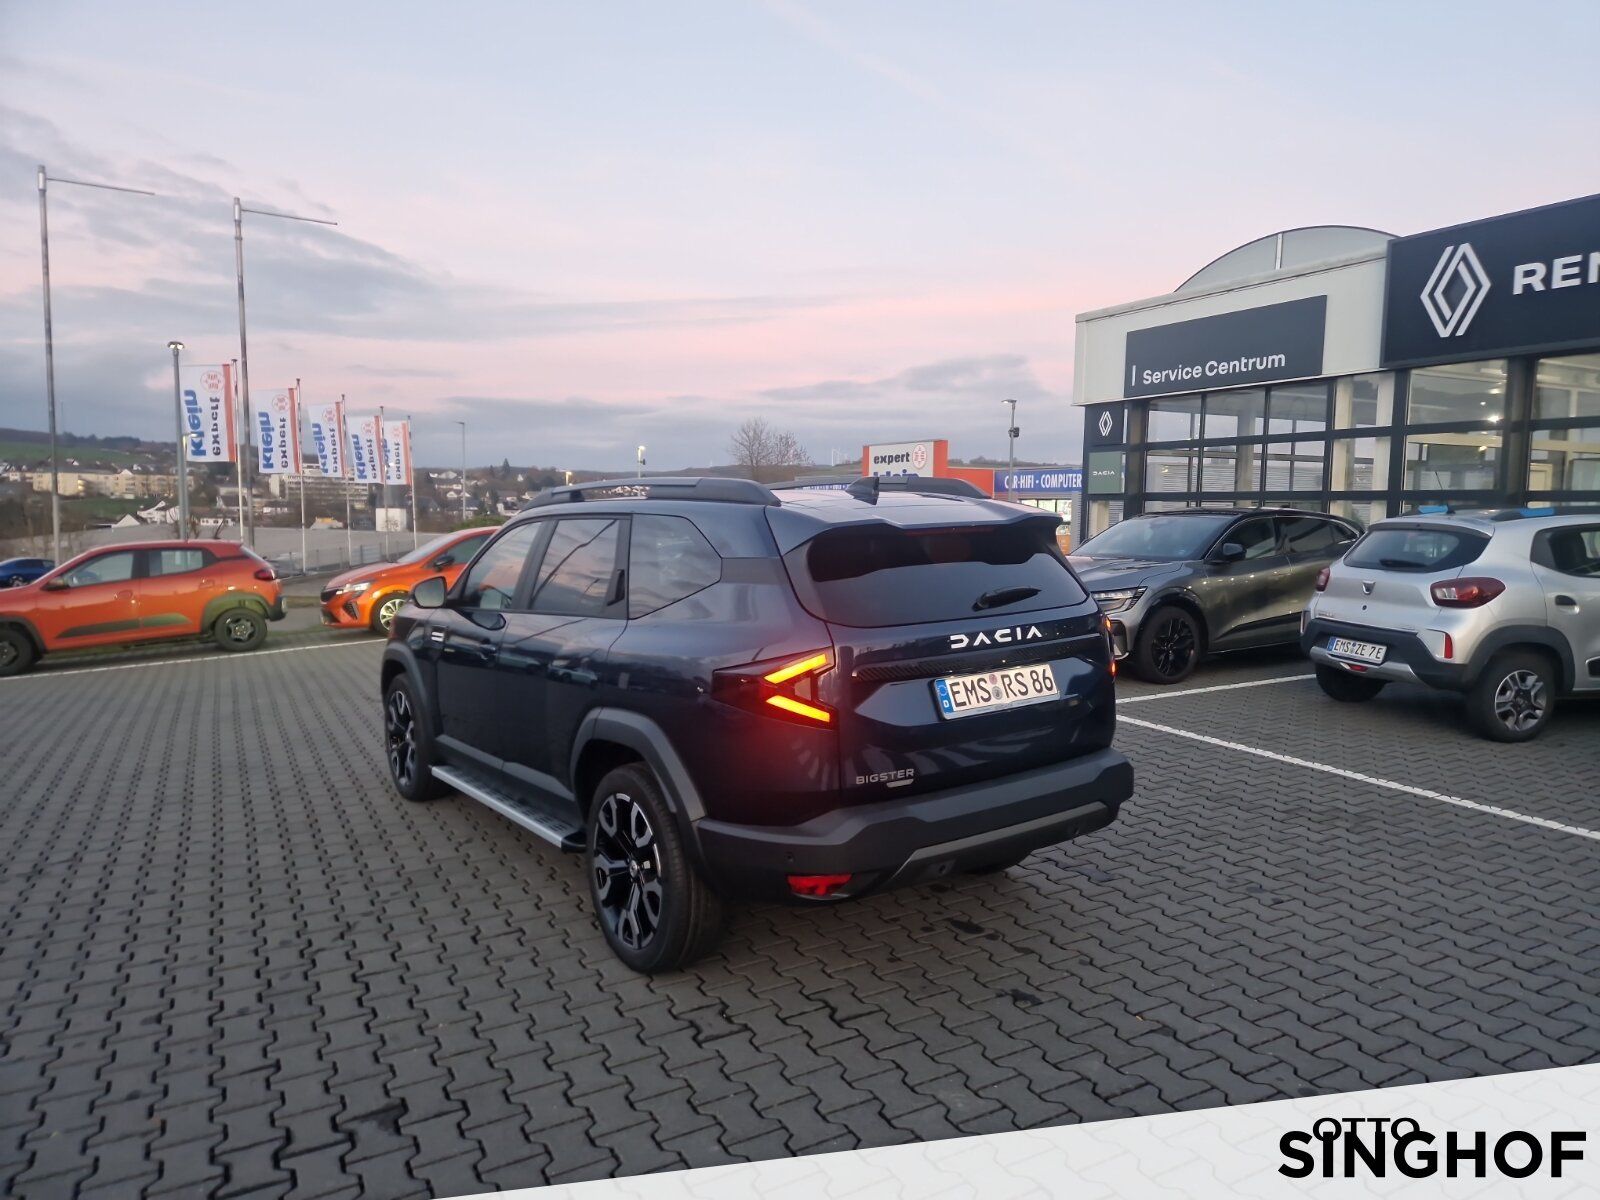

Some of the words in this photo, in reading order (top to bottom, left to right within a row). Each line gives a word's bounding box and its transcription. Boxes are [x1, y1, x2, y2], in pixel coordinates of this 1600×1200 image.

[1142, 363, 1202, 384] Service
[1204, 353, 1286, 377] Centrum
[873, 452, 910, 465] expert
[1004, 474, 1034, 488] CR-HIFI
[1040, 473, 1083, 488] COMPUTER
[949, 625, 1043, 649] DACIA
[949, 677, 992, 708] EMS
[1000, 672, 1029, 698] RS
[1029, 668, 1054, 694] 86
[855, 768, 915, 786] BIGSTER
